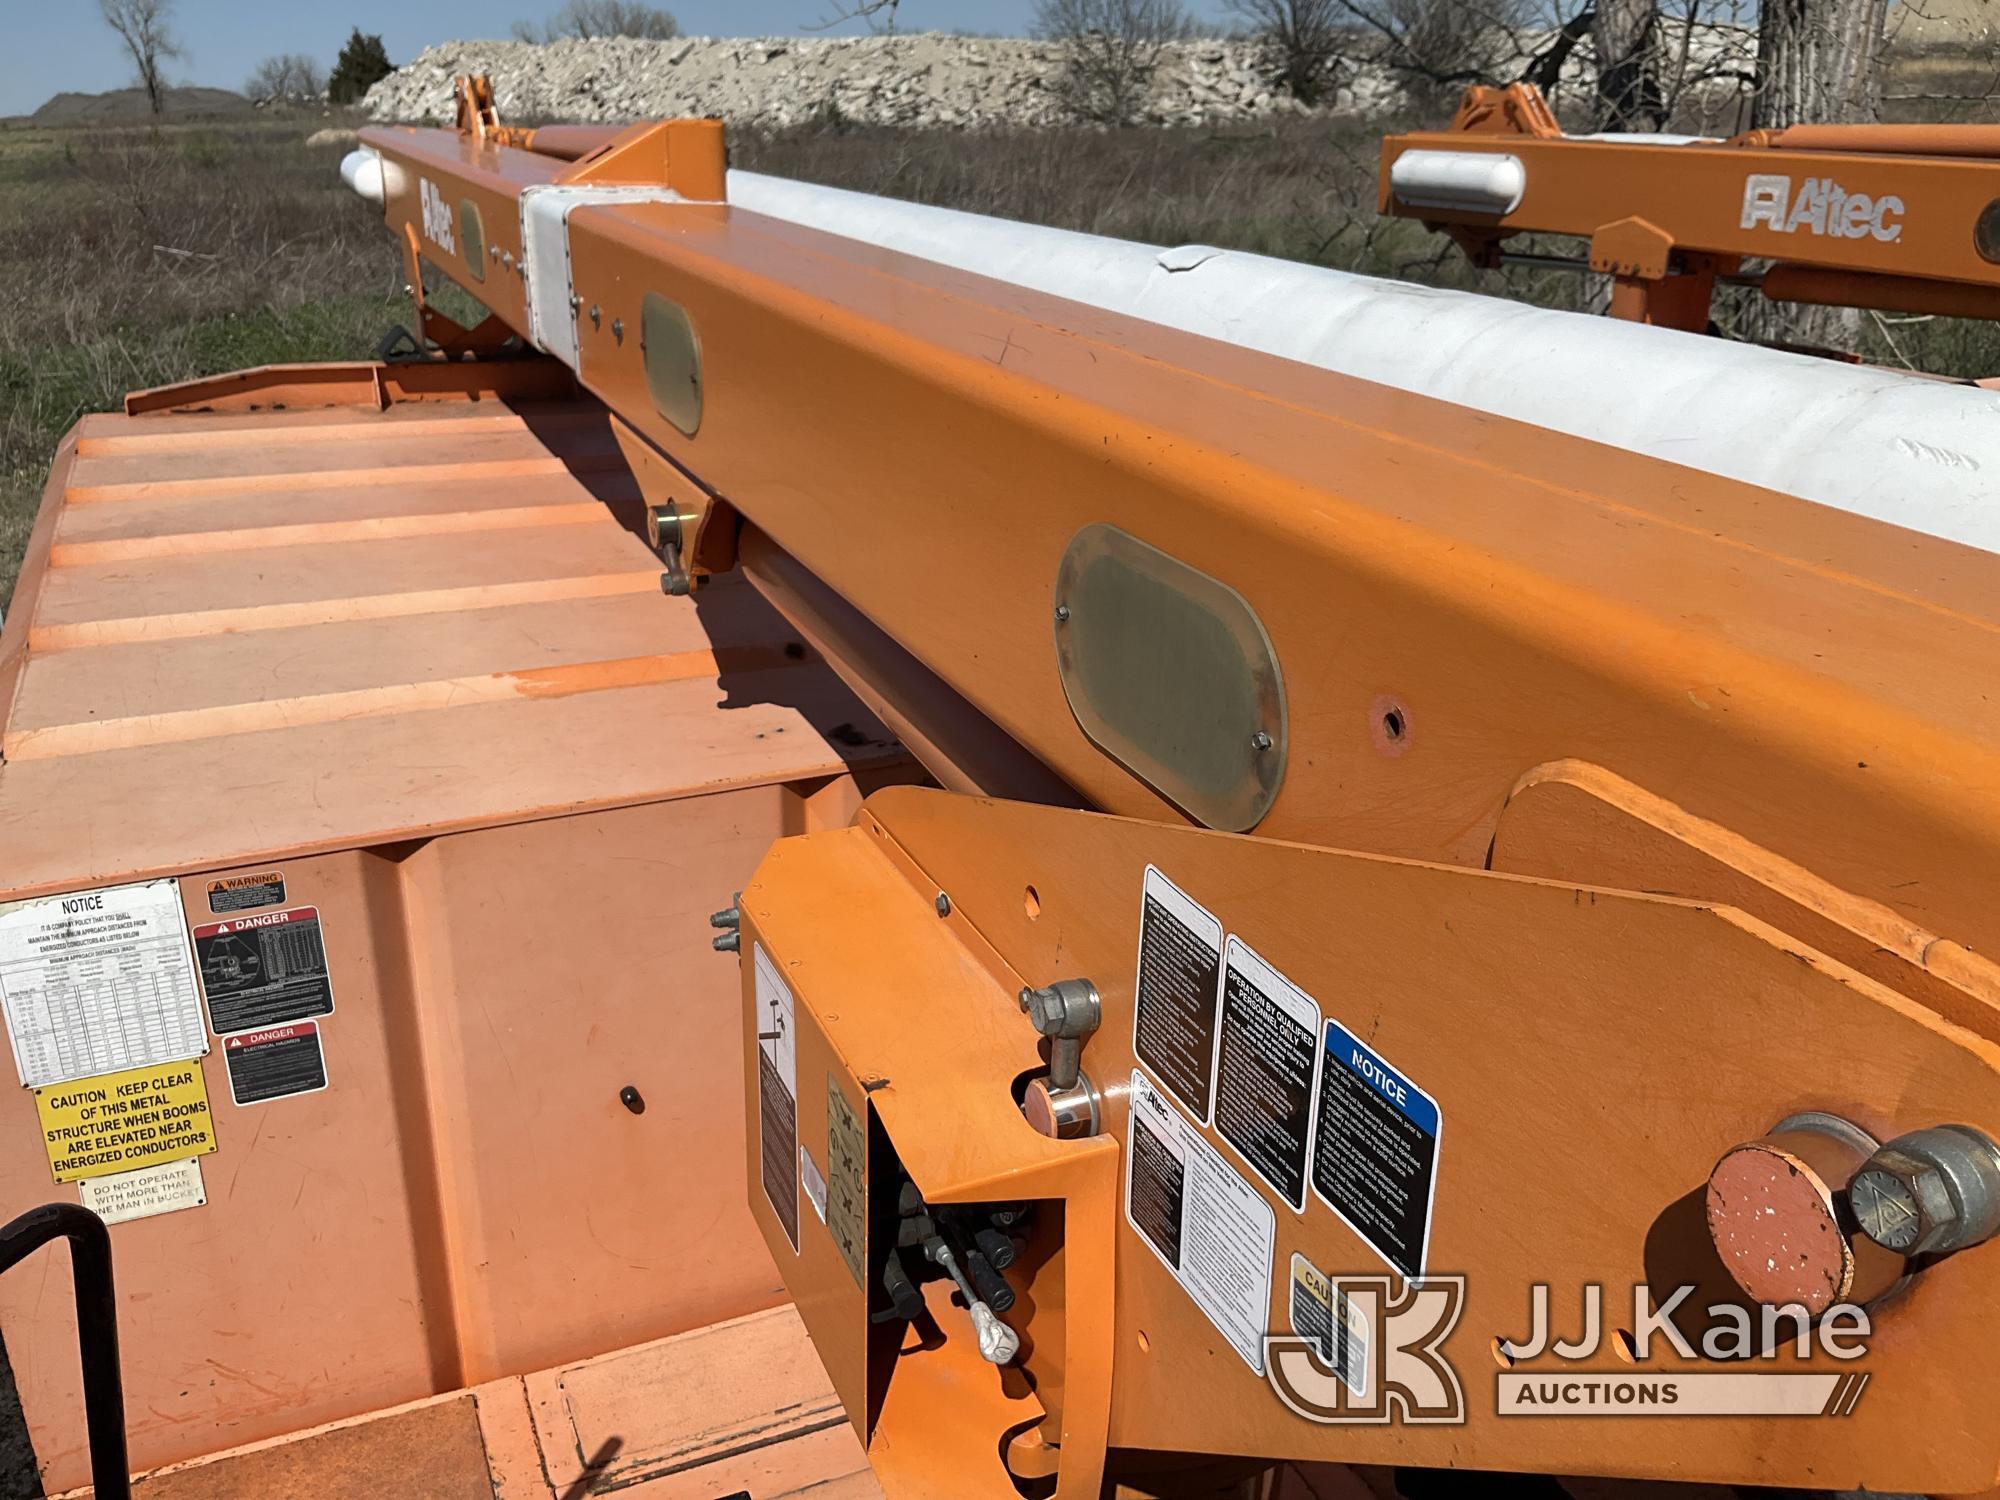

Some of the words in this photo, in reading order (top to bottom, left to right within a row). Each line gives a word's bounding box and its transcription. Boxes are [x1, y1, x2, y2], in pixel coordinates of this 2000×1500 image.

[1784, 177, 1904, 242] Altec
[227, 874, 278, 888] WARNING
[62, 896, 103, 914] NOTICE
[28, 935, 50, 944] MAINTAIN
[82, 926, 107, 935] APPROACH
[108, 922, 133, 931] DISTANCES
[75, 918, 91, 927] POLICY
[92, 916, 103, 924] THAT
[235, 913, 289, 930] DANGER
[40, 942, 66, 952] ENERGIZED
[67, 938, 98, 948] CONDUCTORS
[1228, 970, 1264, 1006] OPERATION
[1266, 999, 1275, 1014] BY
[1277, 1011, 1313, 1047] QUALIFIED
[1239, 990, 1278, 1029] PERSONNEL
[1280, 1024, 1299, 1046] ONLY
[250, 1028, 294, 1043] DANGER
[1352, 1049, 1407, 1107] NOTICE
[51, 1089, 106, 1109] CAUTION
[117, 1081, 149, 1097] KEEP
[152, 1073, 193, 1090] CLEAR
[81, 1106, 97, 1120] OF
[102, 1102, 128, 1116] THIS
[131, 1094, 170, 1110] METAL
[47, 1119, 121, 1142] STRUCTURE
[124, 1112, 160, 1127] WHEN
[163, 1101, 207, 1120] BOOMS
[68, 1140, 93, 1154] ARE
[96, 1127, 156, 1148] ELEVATED
[159, 1120, 192, 1136] NEAR
[54, 1151, 122, 1172] ENERGIZED
[125, 1132, 207, 1158] CONDUCTORS
[94, 1186, 110, 1195] DO
[113, 1180, 135, 1191] NOT
[138, 1170, 187, 1186] OPERATE
[95, 1195, 123, 1205] WITH
[127, 1186, 159, 1198] MORE
[162, 1180, 191, 1191] THAN
[116, 1200, 140, 1211] MAN
[144, 1198, 154, 1206] IN
[159, 1188, 200, 1203] BUCKET
